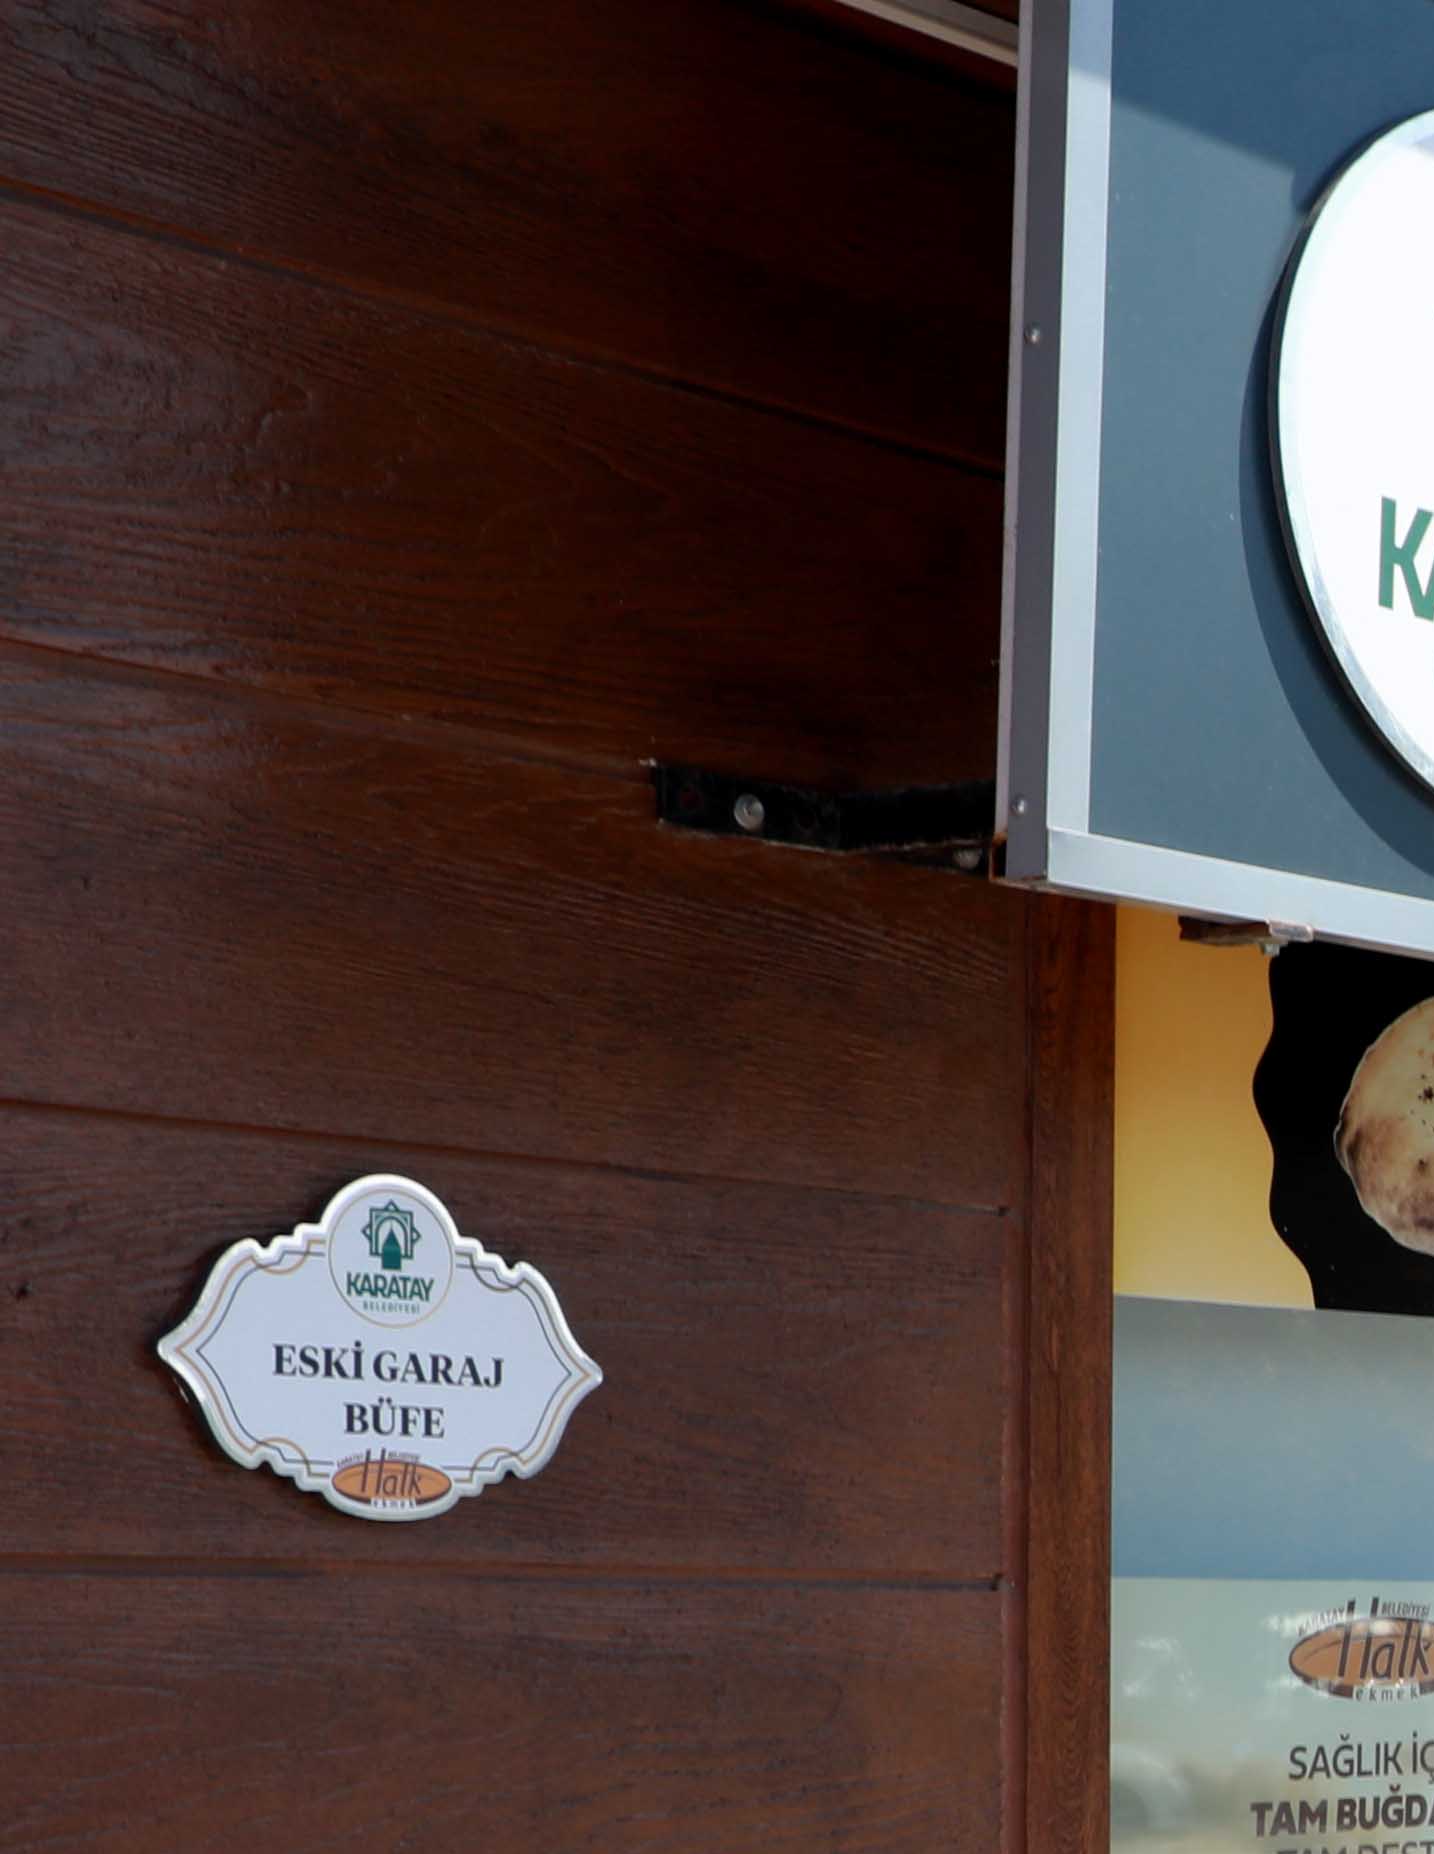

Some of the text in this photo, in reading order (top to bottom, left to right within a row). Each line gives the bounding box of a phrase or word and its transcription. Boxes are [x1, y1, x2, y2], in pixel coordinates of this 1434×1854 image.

[346, 1271, 434, 1302] KARATAY
[272, 1342, 504, 1388] ESKİ GARAJ
[343, 1398, 446, 1439] BÜFE
[361, 1447, 422, 1496] Halk
[1337, 1596, 1433, 1679] Halk
[1288, 1733, 1404, 1781] SAĞLIK
[1250, 1799, 1328, 1838] TAM
